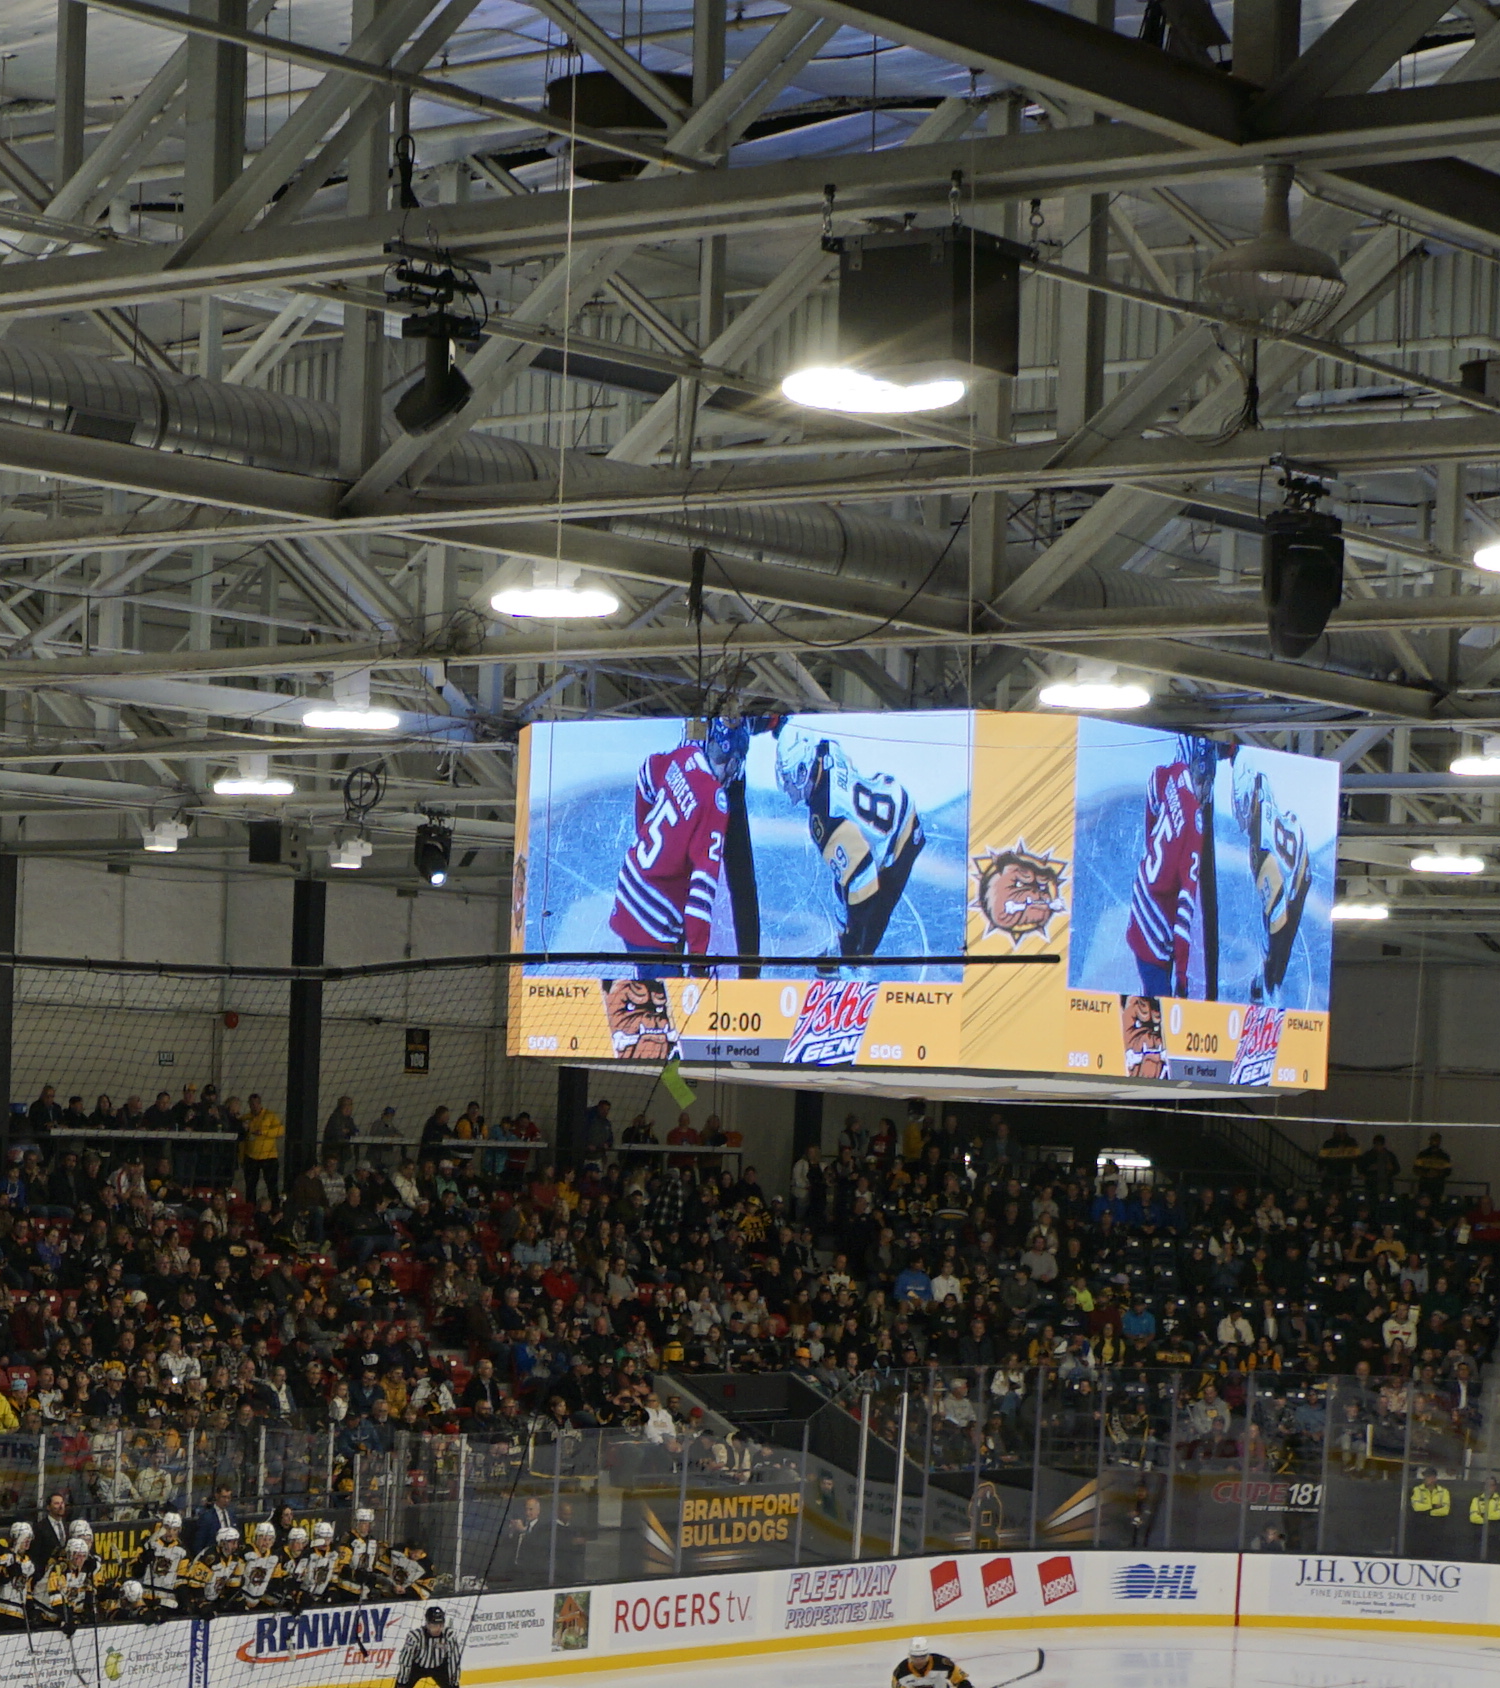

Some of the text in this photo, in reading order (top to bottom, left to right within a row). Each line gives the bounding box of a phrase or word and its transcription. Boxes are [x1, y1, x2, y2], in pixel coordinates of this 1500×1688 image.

[529, 984, 591, 999] PENALTY
[780, 986, 797, 1017] 0
[885, 991, 954, 1006] PENALTY
[1070, 997, 1112, 1014] PENALTY
[707, 1011, 762, 1032] 20:00
[1287, 1018, 1325, 1033] PENALTY
[569, 1036, 579, 1051] 0
[705, 1044, 761, 1057] 1st Period
[869, 1043, 927, 1061] SOG 0
[1186, 1031, 1219, 1054] 20:00
[1068, 1052, 1104, 1070] SOG 0
[1302, 1068, 1309, 1083] 0
[1211, 1480, 1323, 1506] CUPE 181
[681, 1492, 801, 1523] BRANTFORD
[680, 1517, 789, 1548] BULLDOGS
[1112, 1562, 1199, 1601] OHL
[1295, 1558, 1462, 1589] J.H. YOUNG
[786, 1563, 898, 1606] FLEETWAY
[1310, 1588, 1331, 1598] FINE
[1333, 1590, 1385, 1600] JEWELLERS
[1387, 1592, 1417, 1602] SINCE
[506, 1608, 536, 1619] NATIONS
[613, 1589, 751, 1635] ROGERS tv
[784, 1598, 895, 1630] PROPERTIES INC.
[255, 1607, 391, 1655] RENWAY
[507, 1620, 520, 1631] THE
[520, 1617, 546, 1628] WORLD
[342, 1645, 397, 1669] Energy
